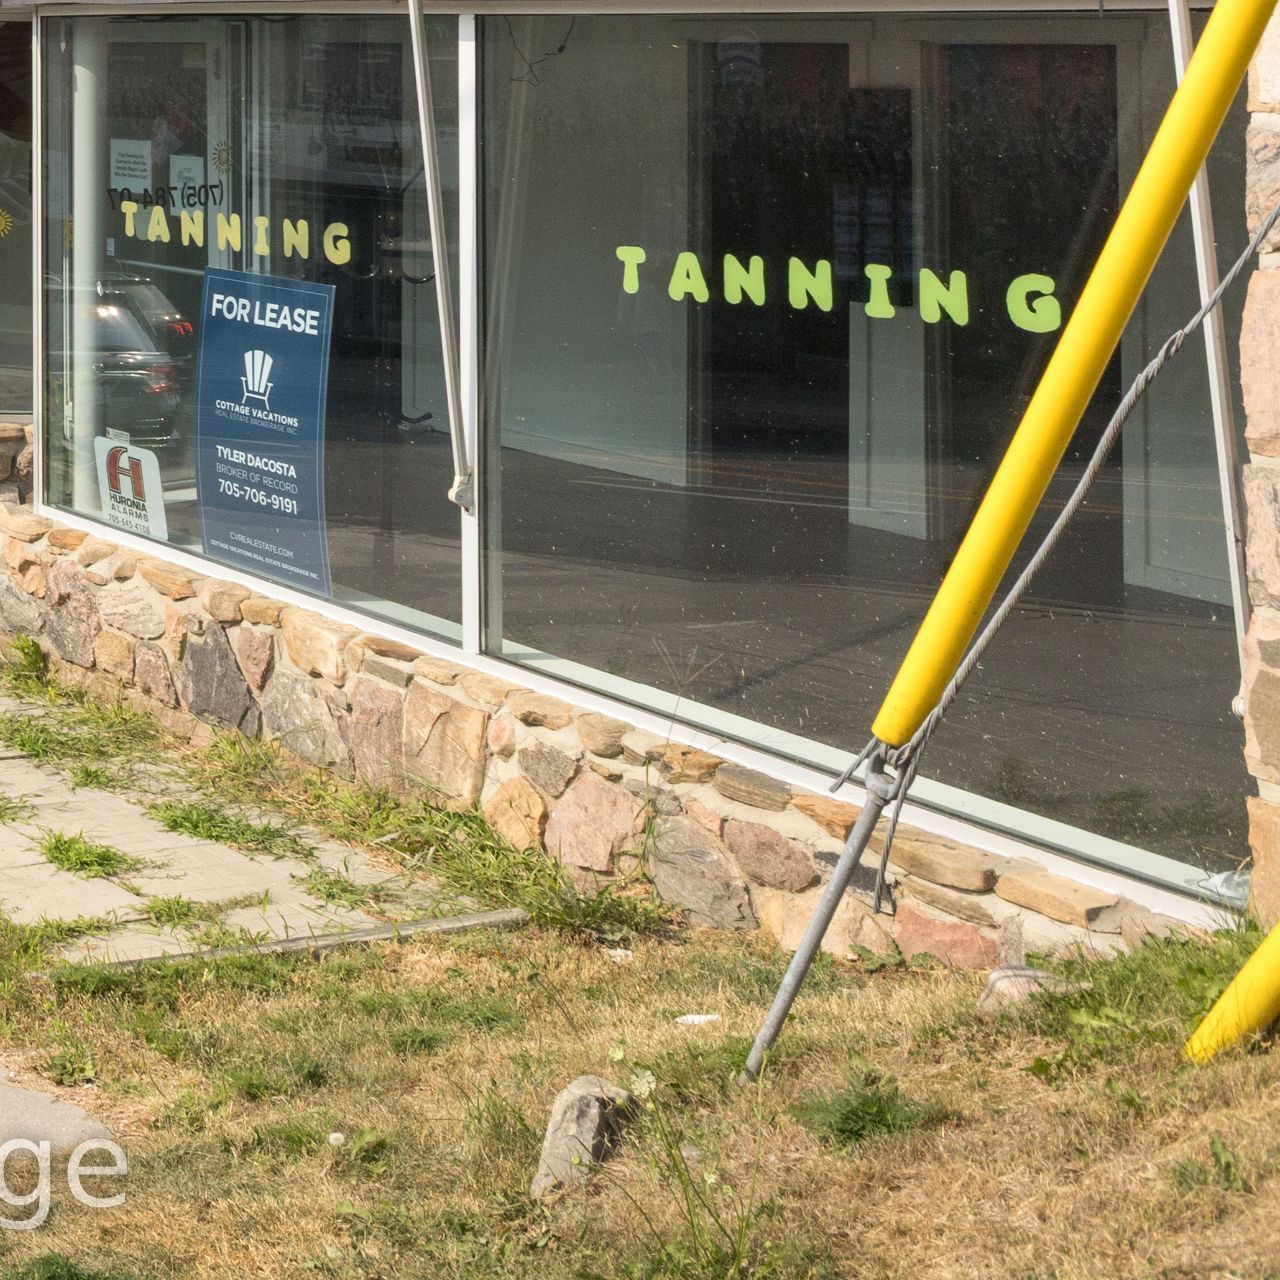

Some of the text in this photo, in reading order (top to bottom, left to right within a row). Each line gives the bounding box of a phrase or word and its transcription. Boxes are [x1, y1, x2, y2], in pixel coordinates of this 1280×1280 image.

[120, 200, 352, 265] TANNING
[616, 245, 1062, 334] TANNING
[211, 293, 320, 336] FOR LEASE
[215, 399, 299, 428] COTTAGE VACATIONS
[216, 445, 298, 479] TYLER DACOSTA
[216, 463, 298, 495] BROKER OF RECORD
[109, 493, 148, 513] HURONIA
[111, 504, 149, 523] ALARMS
[218, 478, 298, 515] 705-706-9191
